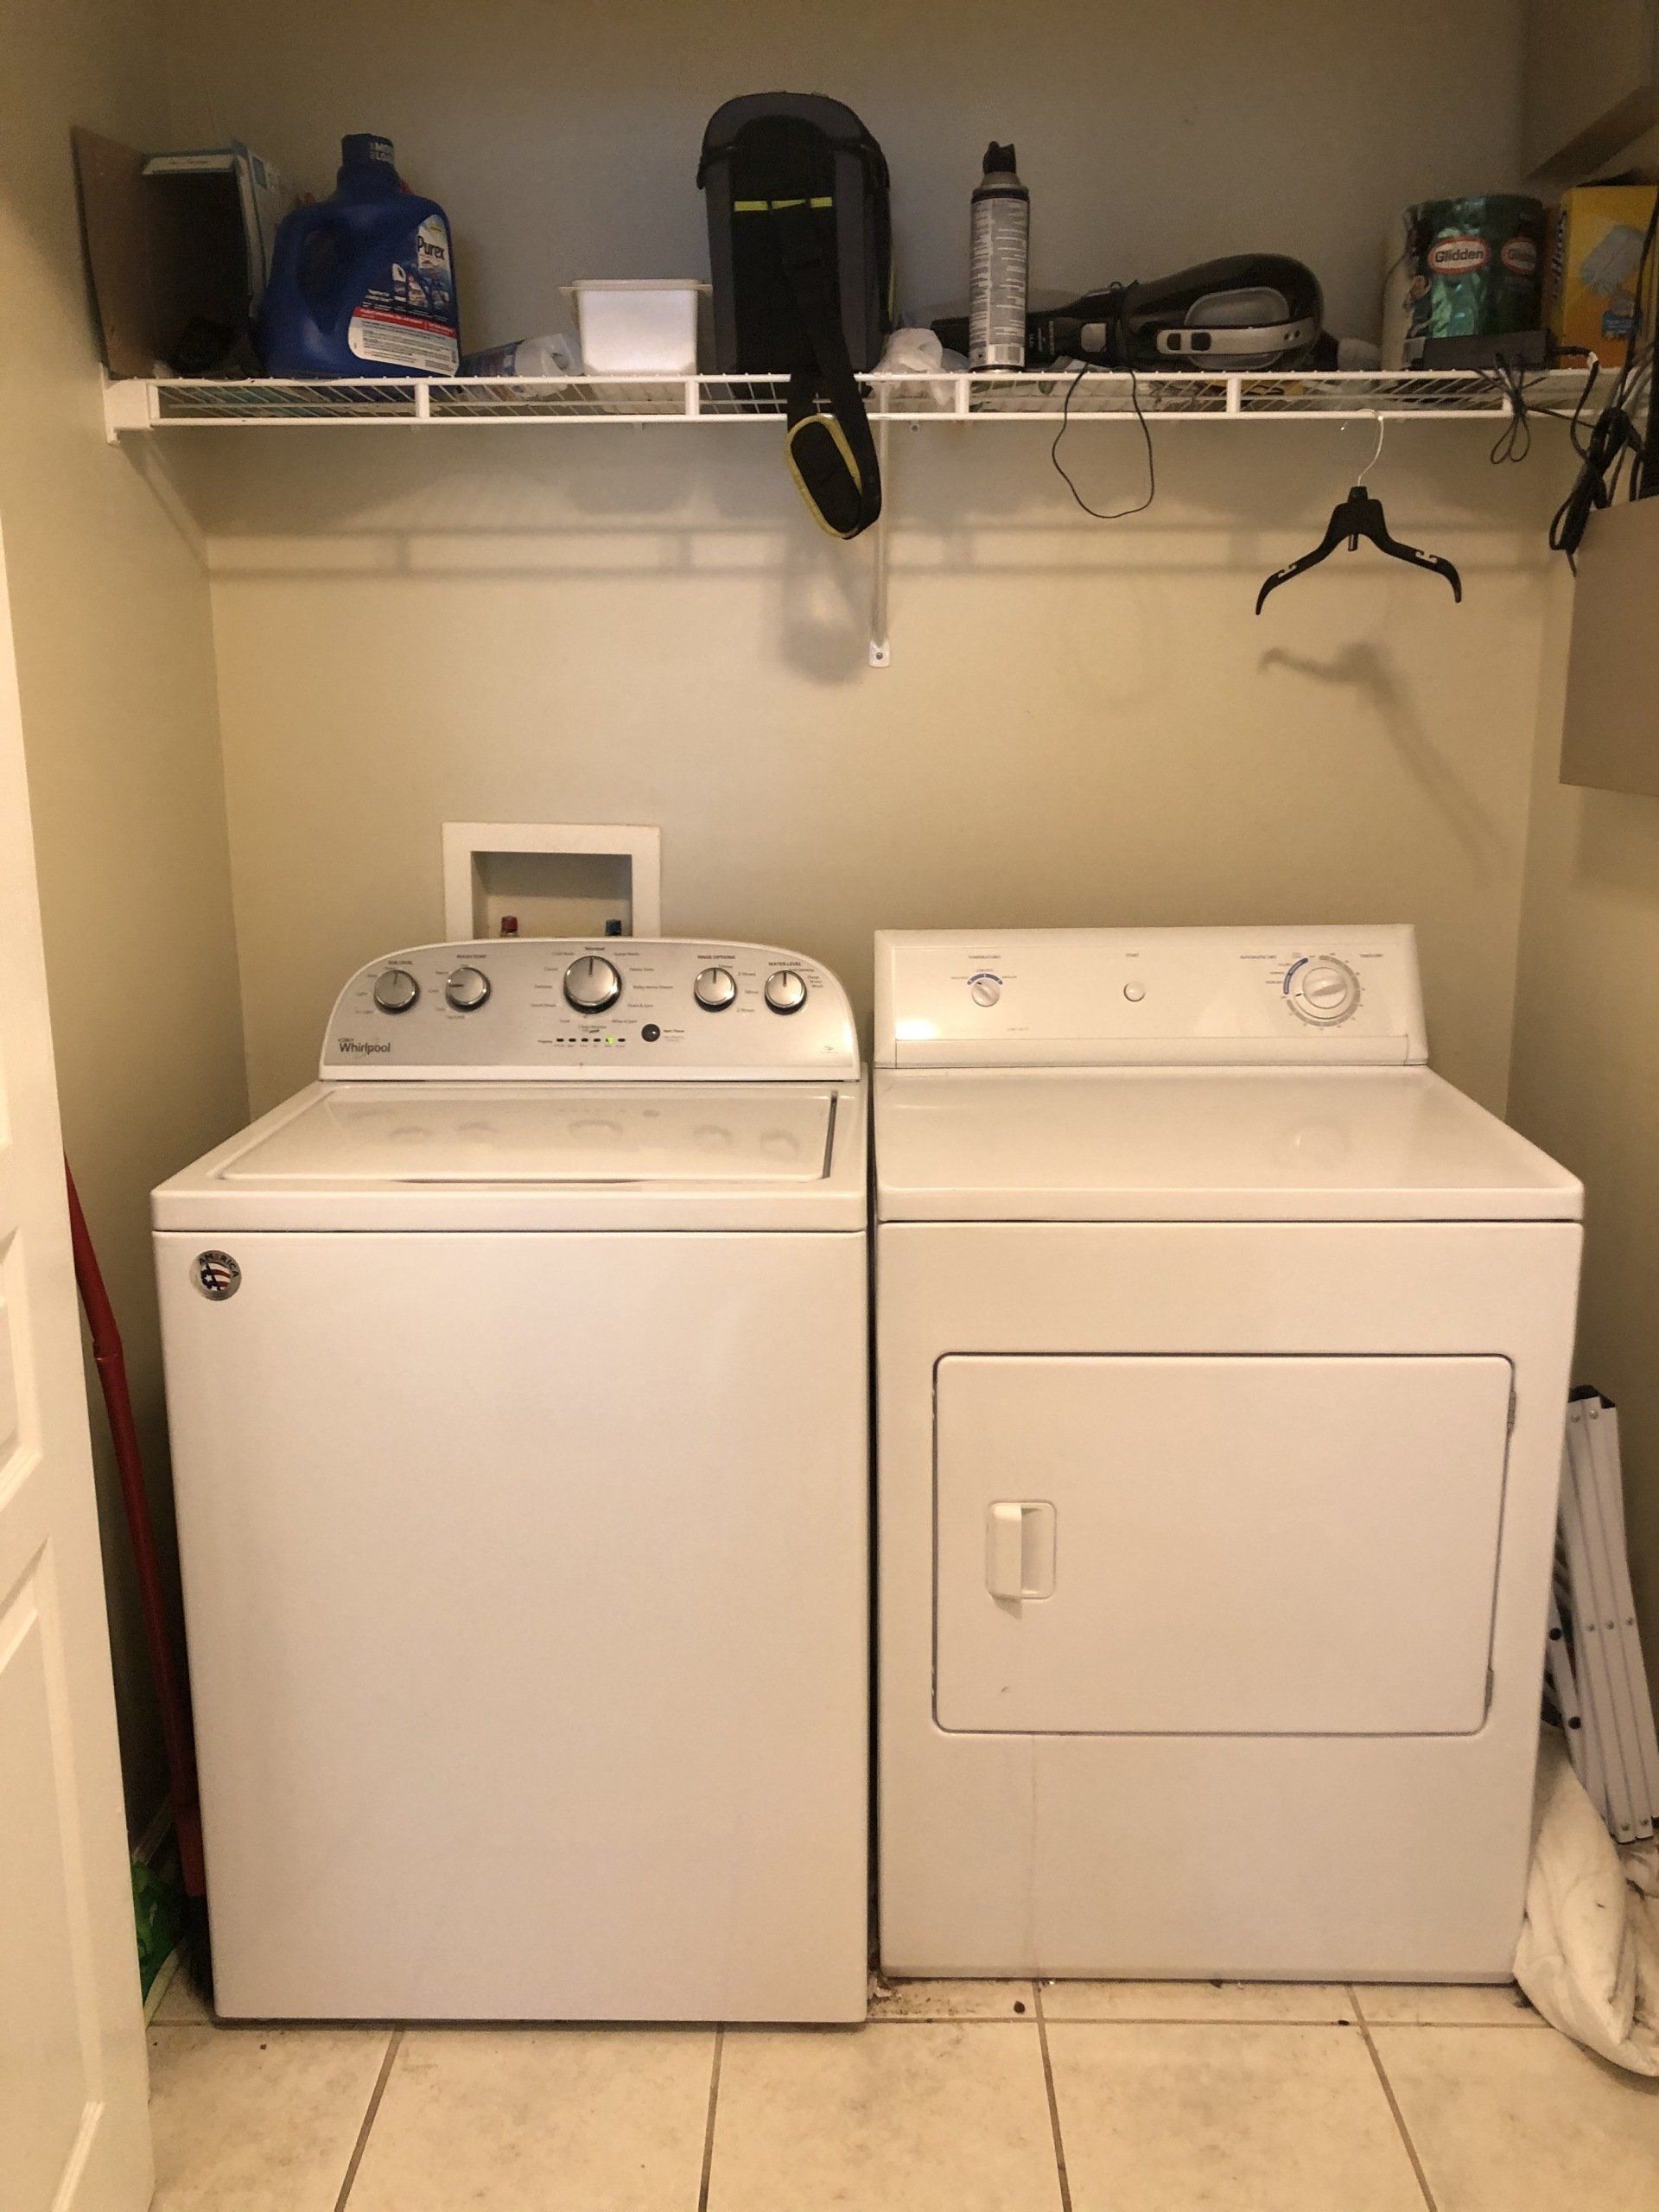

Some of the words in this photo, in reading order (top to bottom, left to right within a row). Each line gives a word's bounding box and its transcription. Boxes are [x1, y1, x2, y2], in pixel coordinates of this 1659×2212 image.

[417, 235, 444, 259] Purex
[1434, 249, 1484, 264] Glidden
[340, 1042, 391, 1055] Whirlpool
